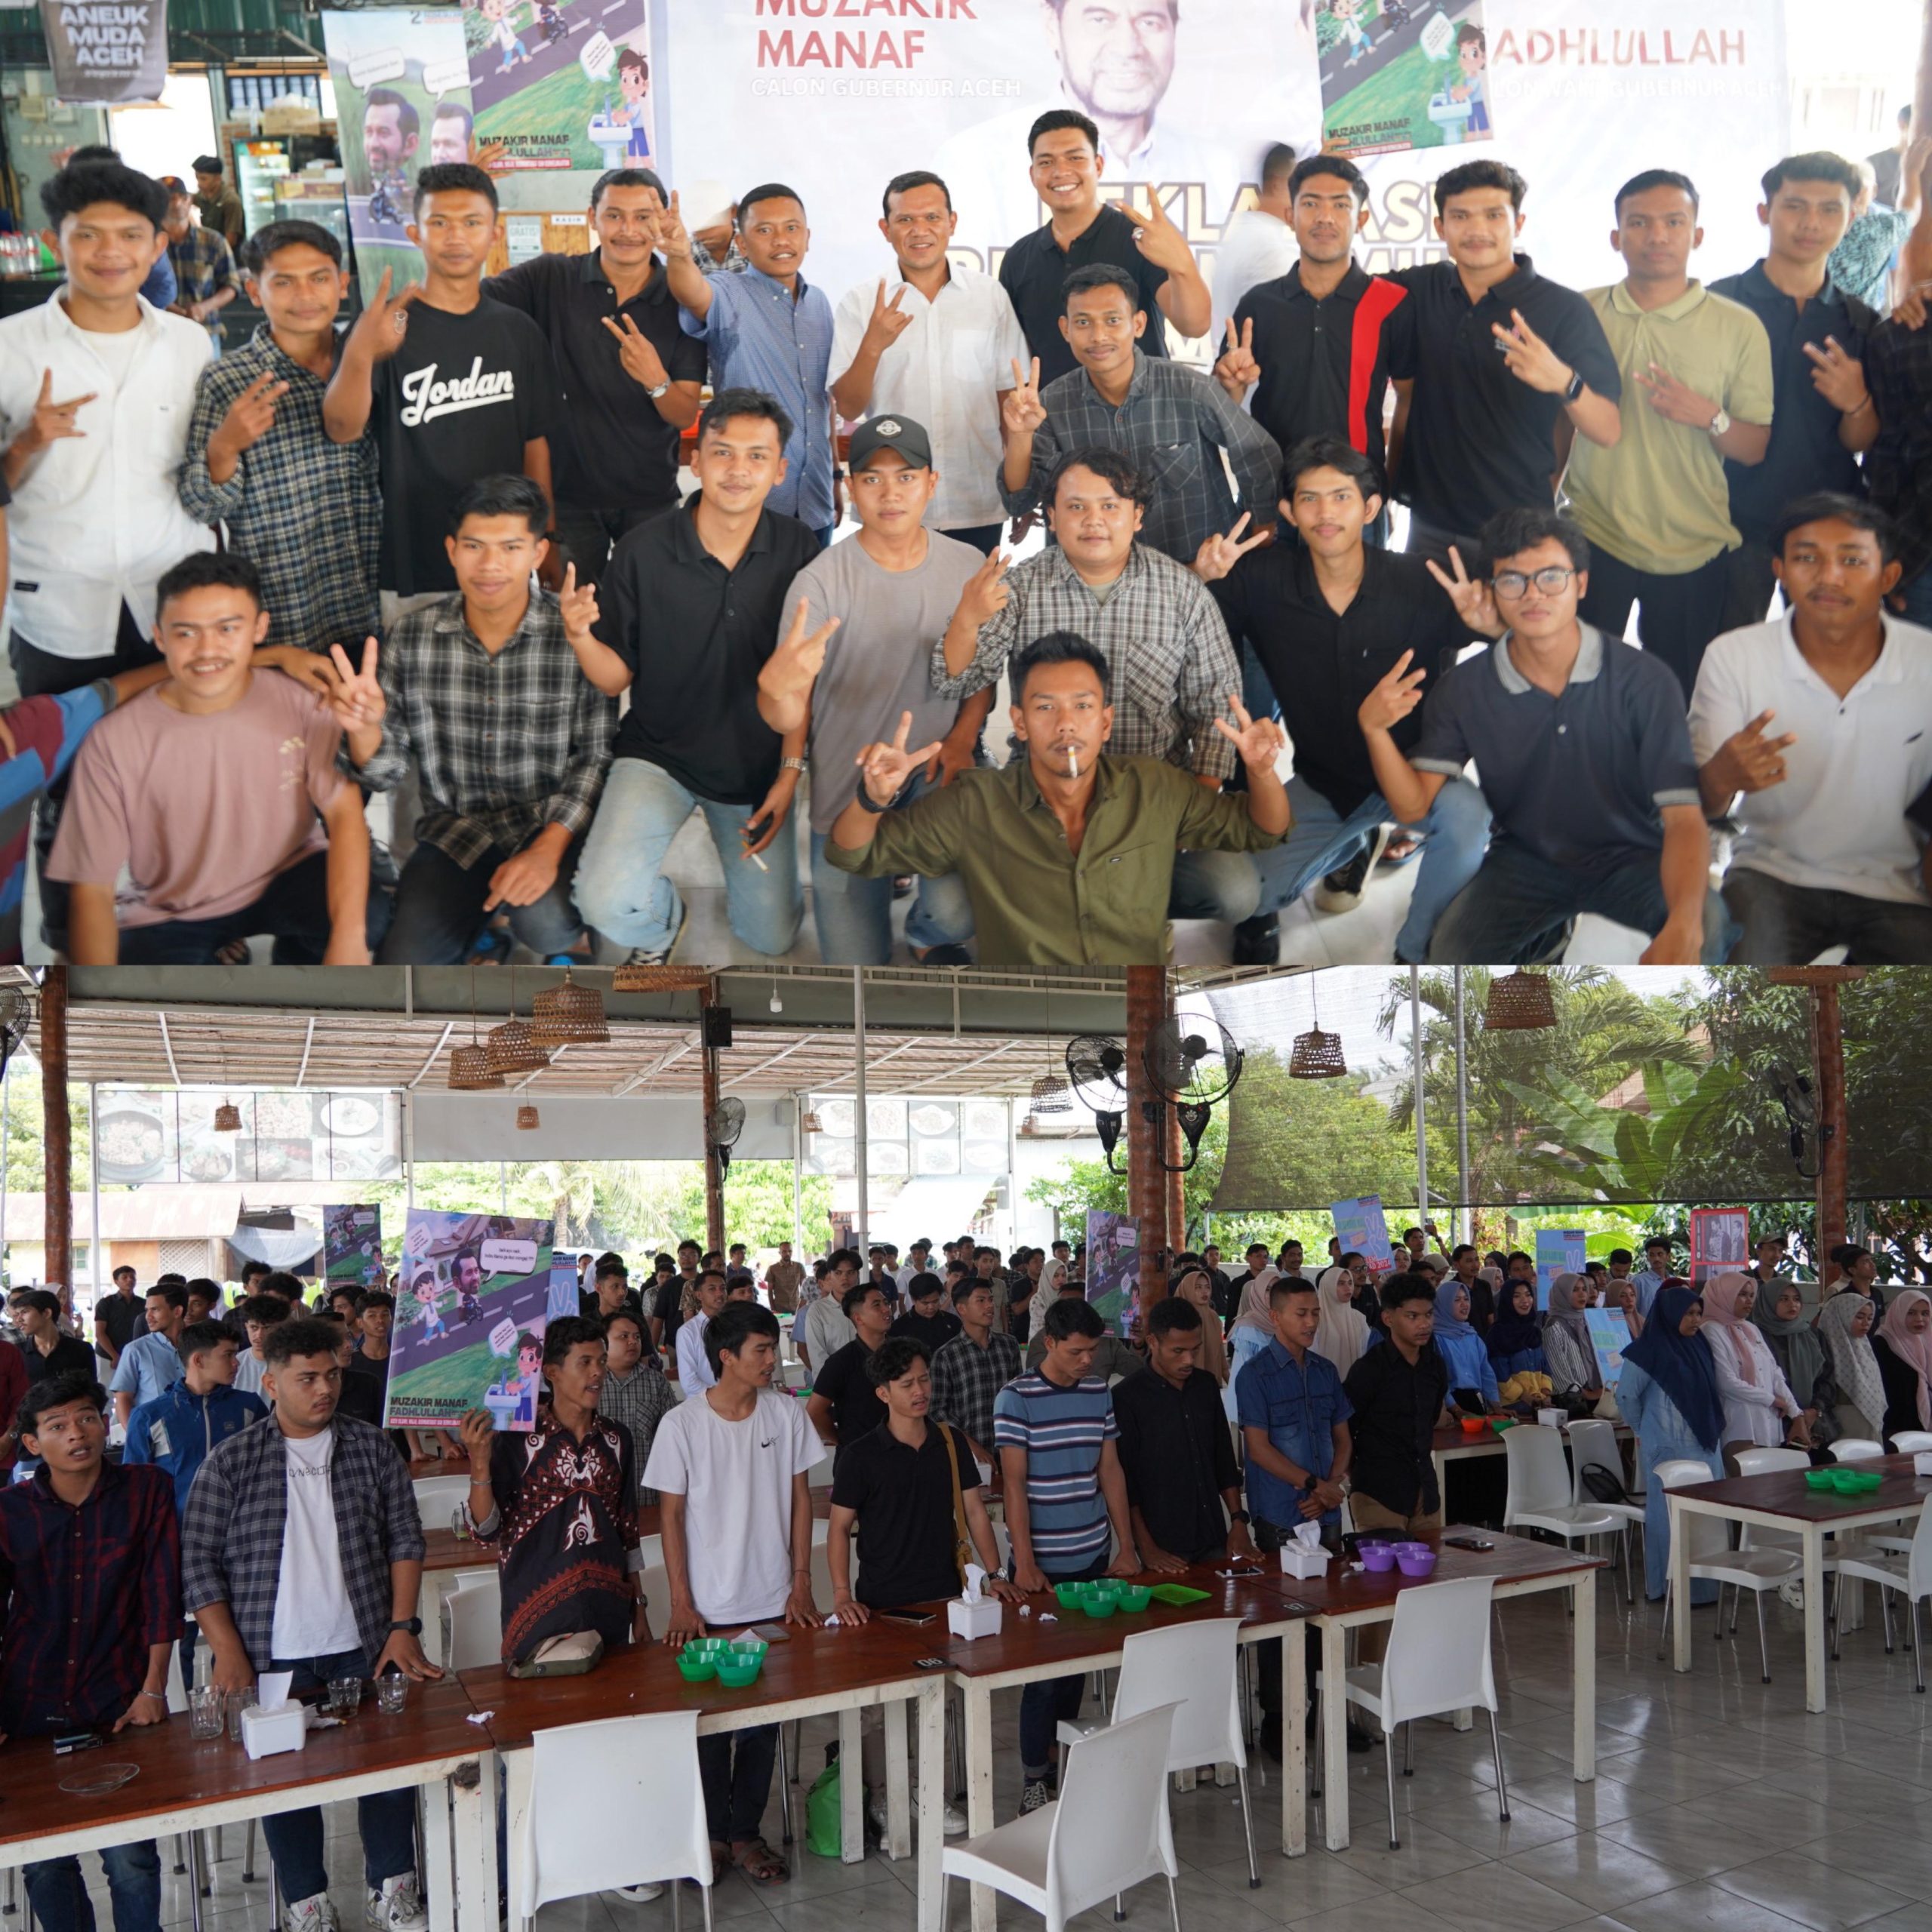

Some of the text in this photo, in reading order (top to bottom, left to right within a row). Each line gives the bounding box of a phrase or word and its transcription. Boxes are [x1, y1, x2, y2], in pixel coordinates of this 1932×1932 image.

[60, 5, 149, 26] ANEUK
[66, 26, 146, 46] MUDA
[76, 46, 143, 66] ACEH
[758, 30, 924, 68] MANAF
[1492, 27, 1747, 66] ADHLULLAH
[751, 78, 1021, 97] CALON GUBERNUR ACEH
[1609, 75, 1727, 98] GUBERNUR
[1327, 118, 1411, 138] MUZAKIR MANAF
[531, 134, 570, 145] MANAF
[401, 355, 515, 427] Jordan
[389, 1407, 451, 1417] FADHLULLAH
[391, 1396, 468, 1408] MUZAKIR MANAF
[917, 1657, 943, 1666] 06
